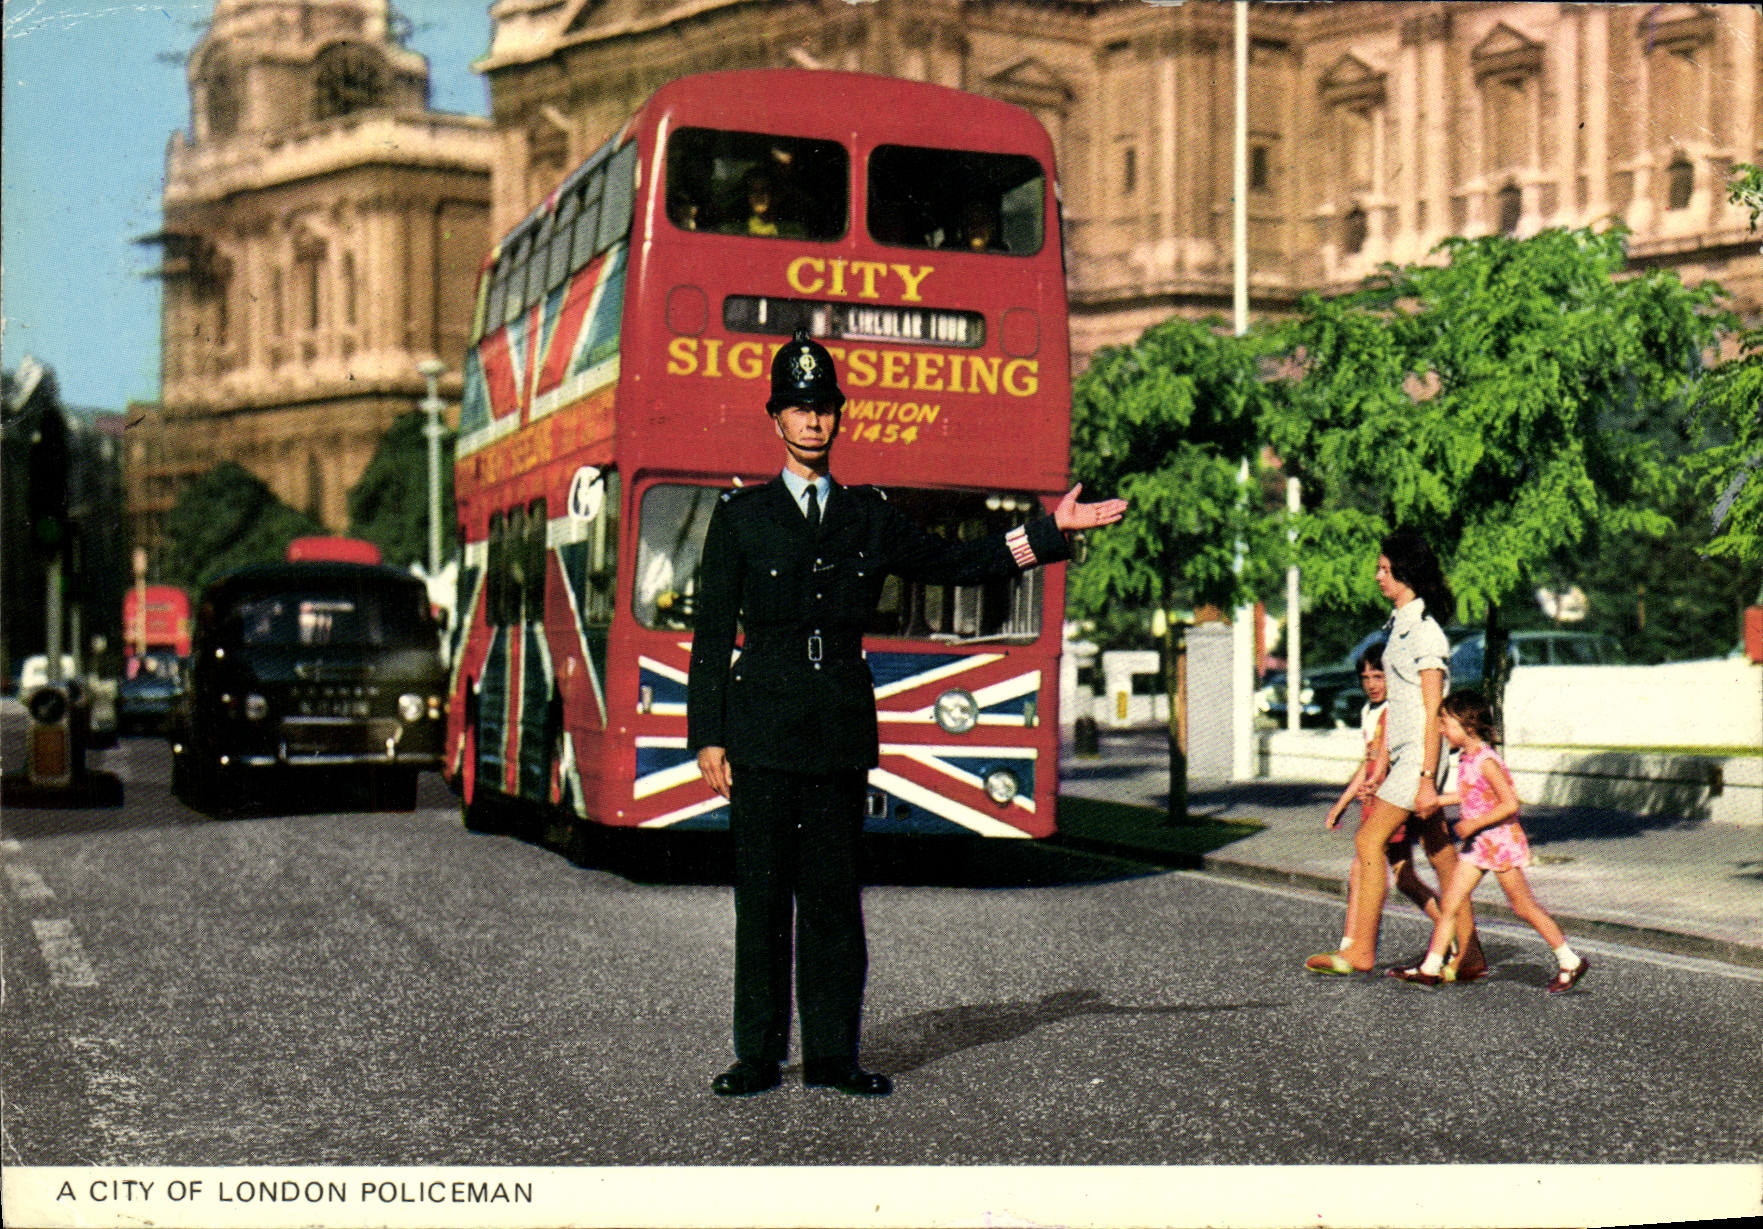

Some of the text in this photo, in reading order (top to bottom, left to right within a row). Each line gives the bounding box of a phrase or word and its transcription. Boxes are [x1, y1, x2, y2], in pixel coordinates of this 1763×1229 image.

[786, 255, 935, 302] CITY
[667, 337, 1040, 398] SIGSEEING
[840, 399, 941, 424] VATION
